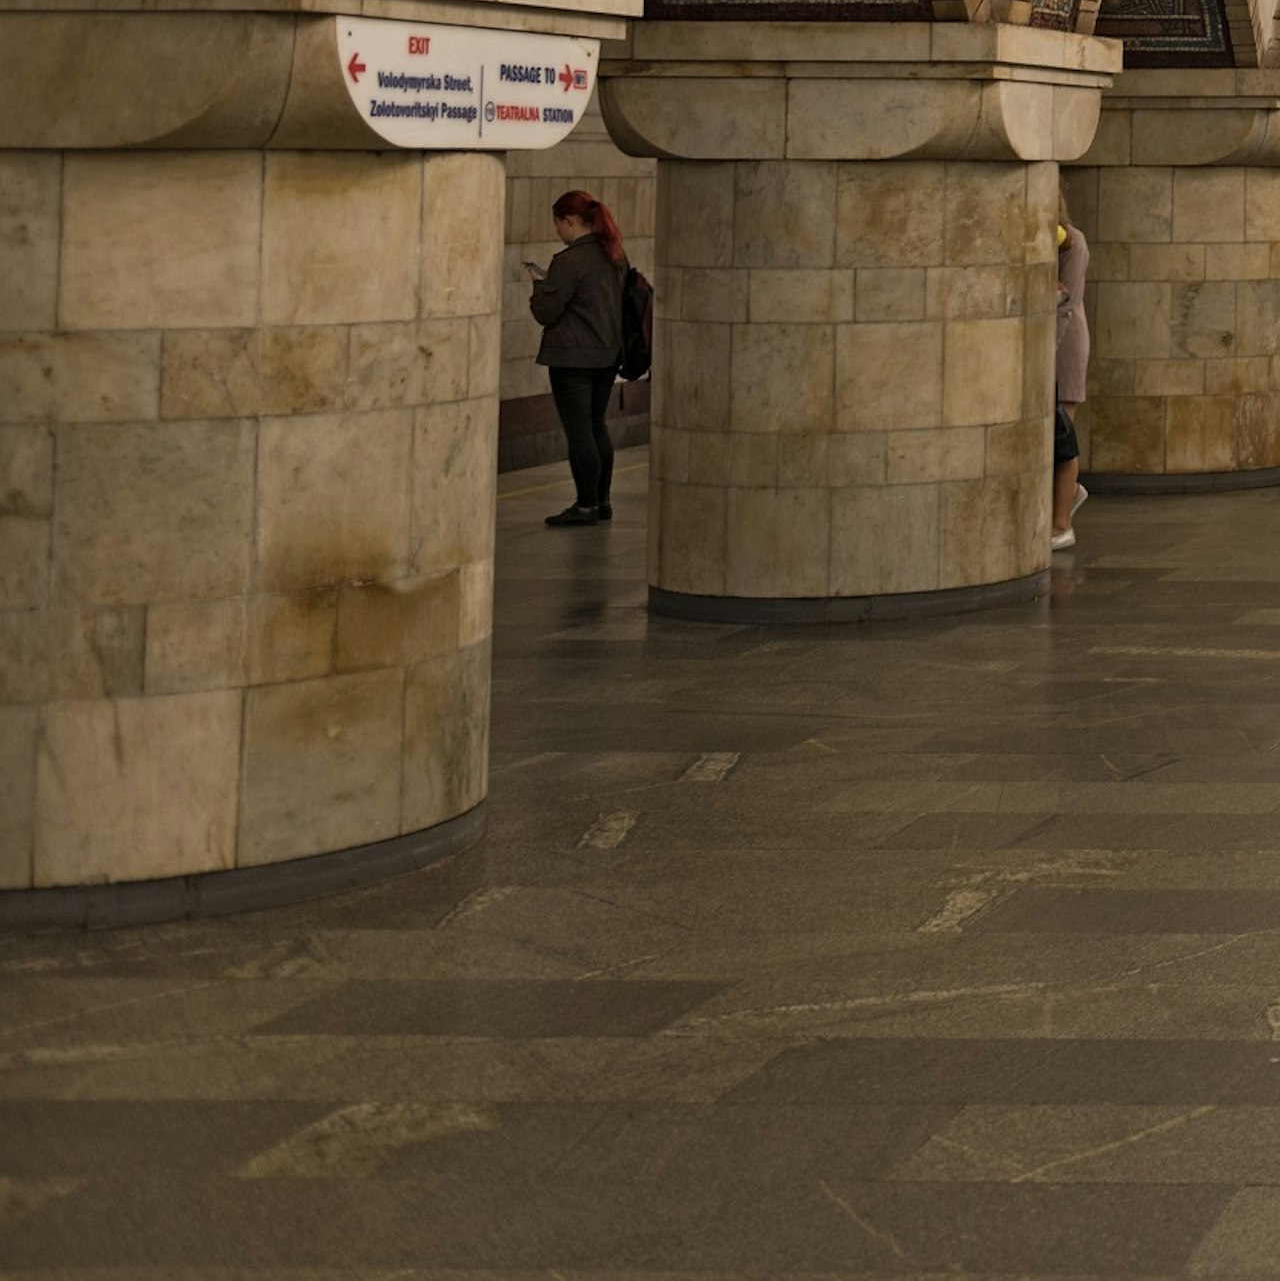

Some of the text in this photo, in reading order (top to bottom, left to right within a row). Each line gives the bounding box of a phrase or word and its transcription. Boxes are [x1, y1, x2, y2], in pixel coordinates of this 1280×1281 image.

[409, 36, 430, 54] EXIT
[377, 71, 473, 94] Volodymyrska Street,
[500, 64, 542, 83] PASSAGE
[544, 67, 556, 84] TO
[441, 102, 478, 123] Passage
[496, 105, 540, 121] TEATRALNA
[543, 108, 574, 123] STATION
